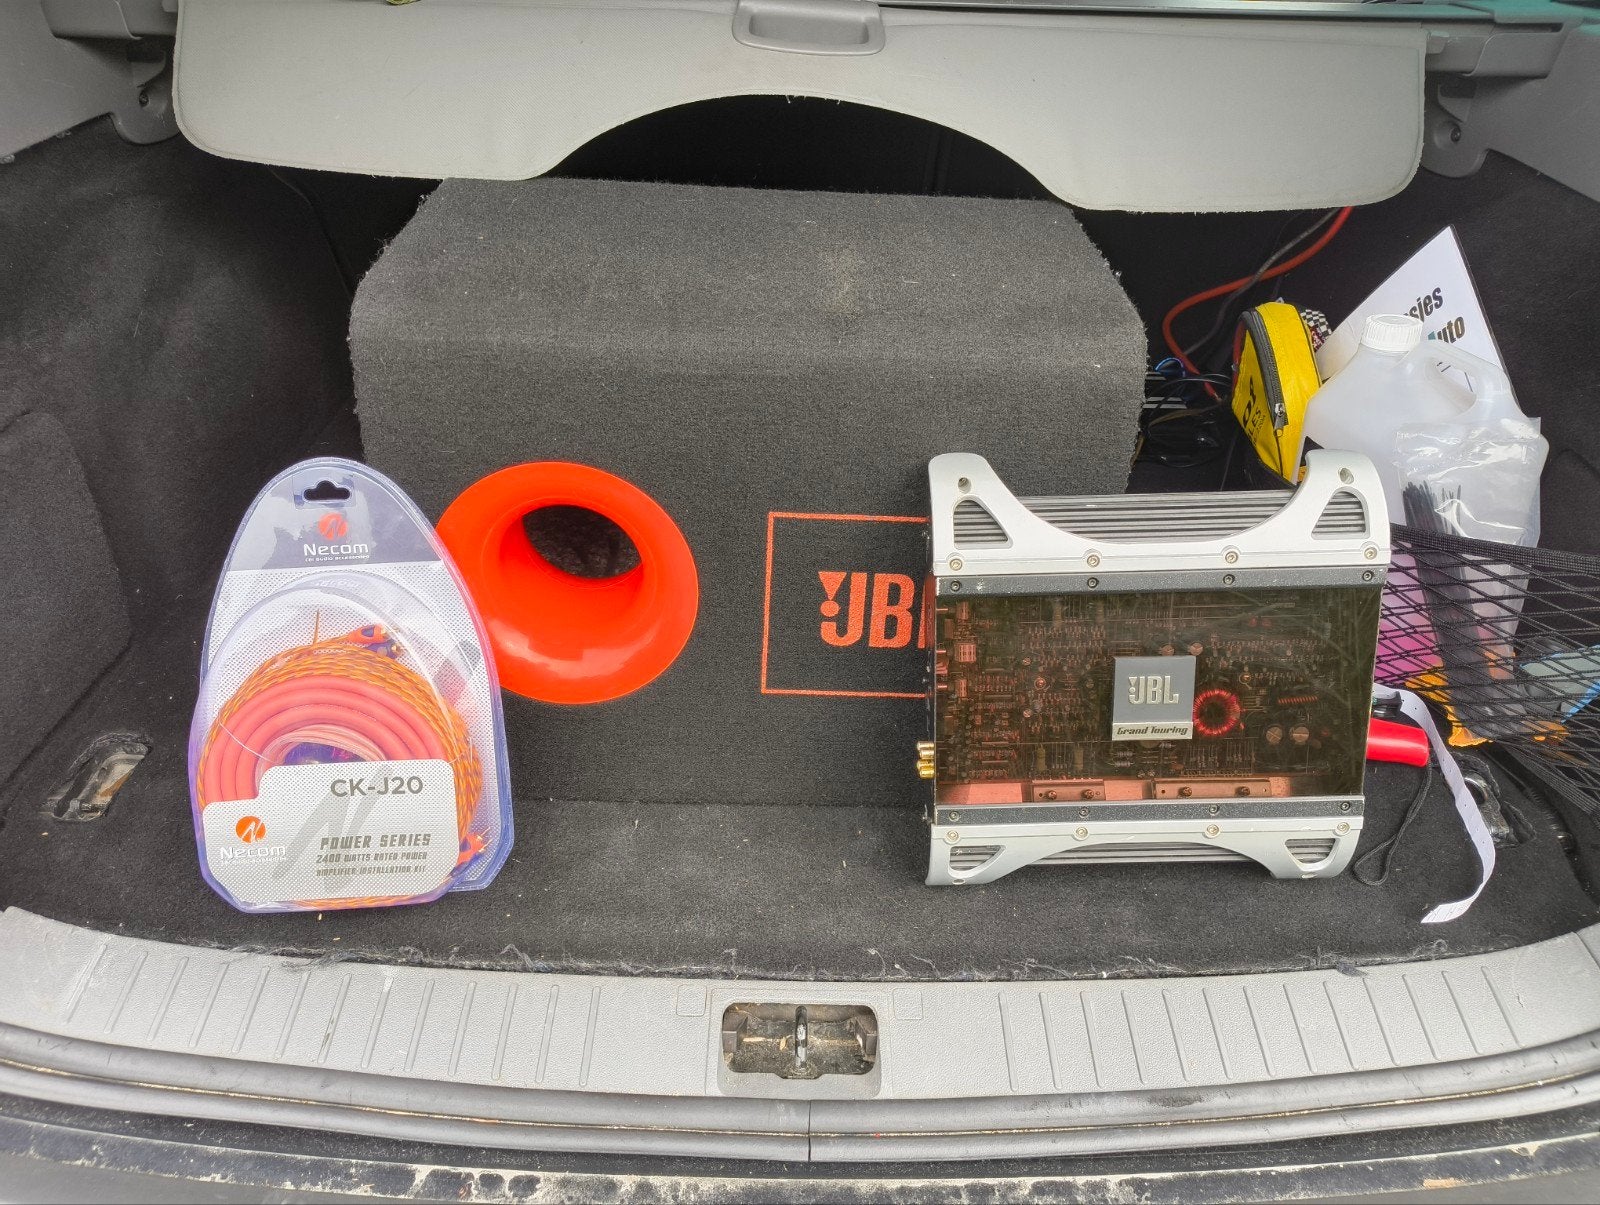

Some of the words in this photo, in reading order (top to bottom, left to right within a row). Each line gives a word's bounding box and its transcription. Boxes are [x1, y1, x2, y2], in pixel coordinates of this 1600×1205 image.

[303, 543, 369, 556] Necom
[1128, 675, 1180, 705] JBL
[1116, 726, 1149, 736] Grand
[1150, 725, 1189, 736] Touring
[330, 775, 424, 798] CK-J20
[319, 835, 372, 850] POWER
[379, 833, 432, 848] SERIES
[220, 846, 286, 860] Necom
[316, 853, 342, 864] 2400
[344, 853, 372, 862] WATTS
[373, 852, 399, 861] RATED
[400, 851, 428, 860] POWER
[316, 867, 357, 877] AMPLIFIER
